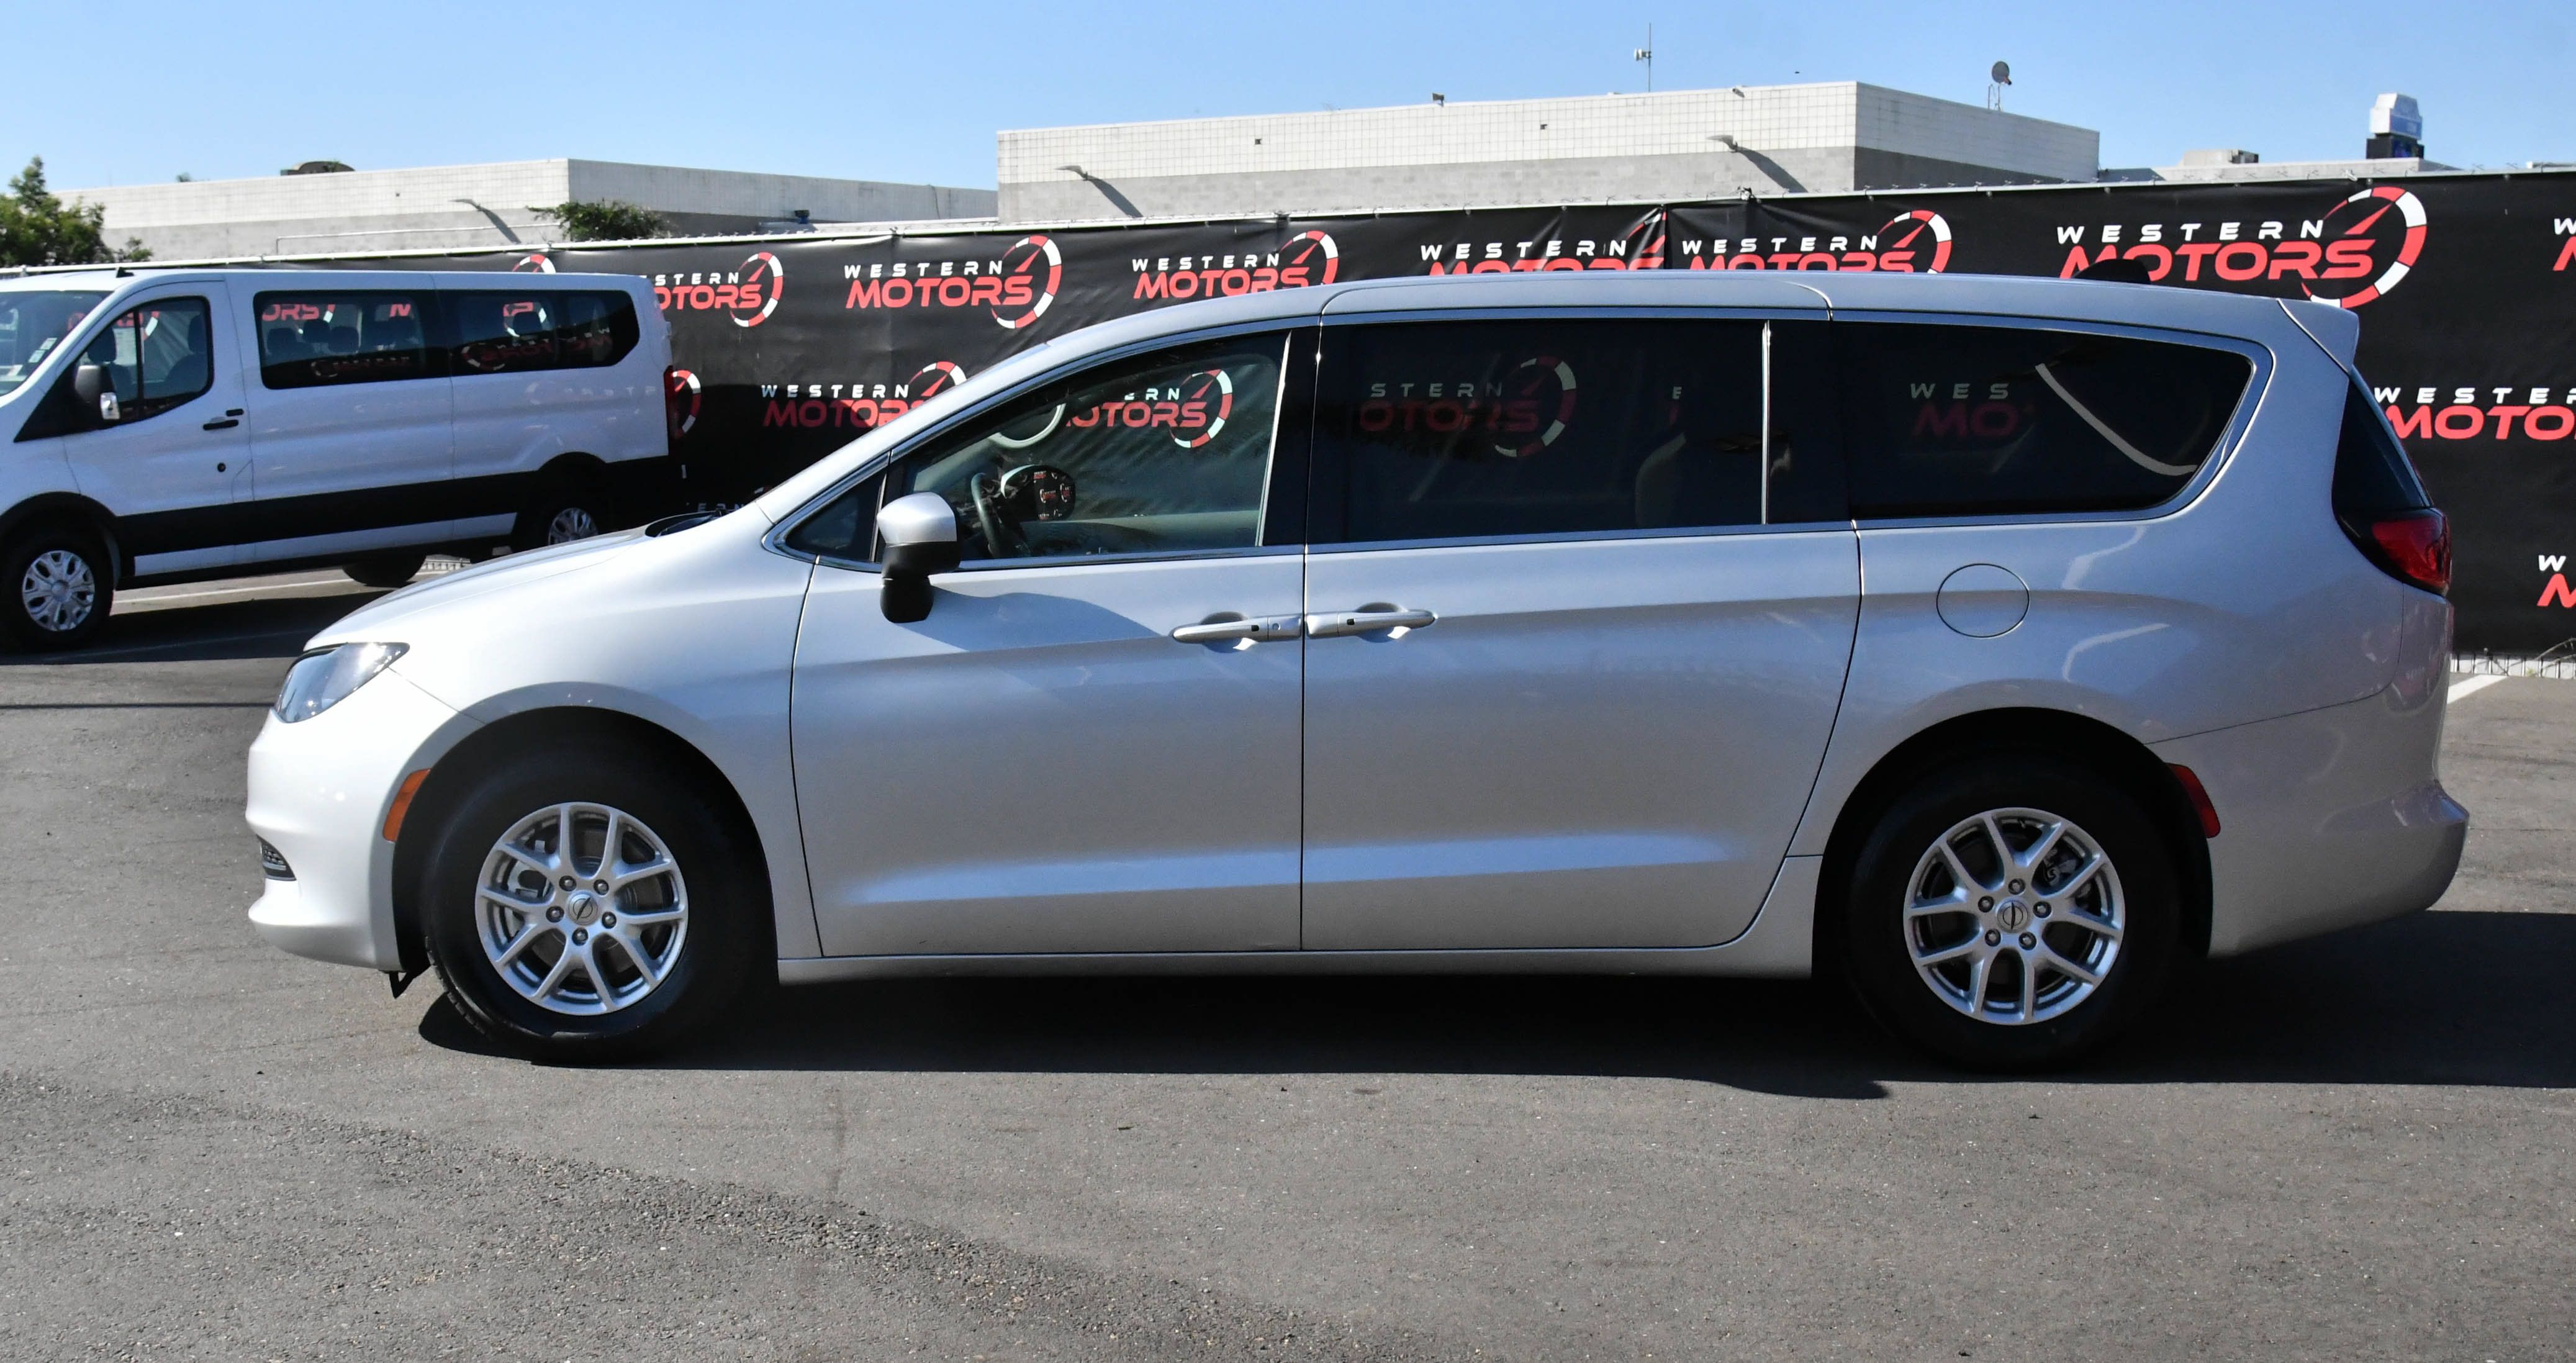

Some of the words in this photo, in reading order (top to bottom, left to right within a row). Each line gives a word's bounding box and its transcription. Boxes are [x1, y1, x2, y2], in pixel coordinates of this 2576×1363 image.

[2057, 220, 2323, 244] WESTERN
[1421, 240, 1626, 260] WESTERN
[1683, 235, 1877, 255] WESTERN
[844, 260, 1002, 279] WESTERN
[1132, 253, 1279, 272] WESTERN
[639, 272, 739, 286] STERN
[1133, 267, 1310, 299] MOTORS
[846, 275, 1033, 309] MOTORS
[761, 384, 909, 398] WESTERN
[763, 399, 924, 428] MOTOR
[1066, 402, 1207, 427] OTORS
[2385, 405, 2576, 440] MOTO
